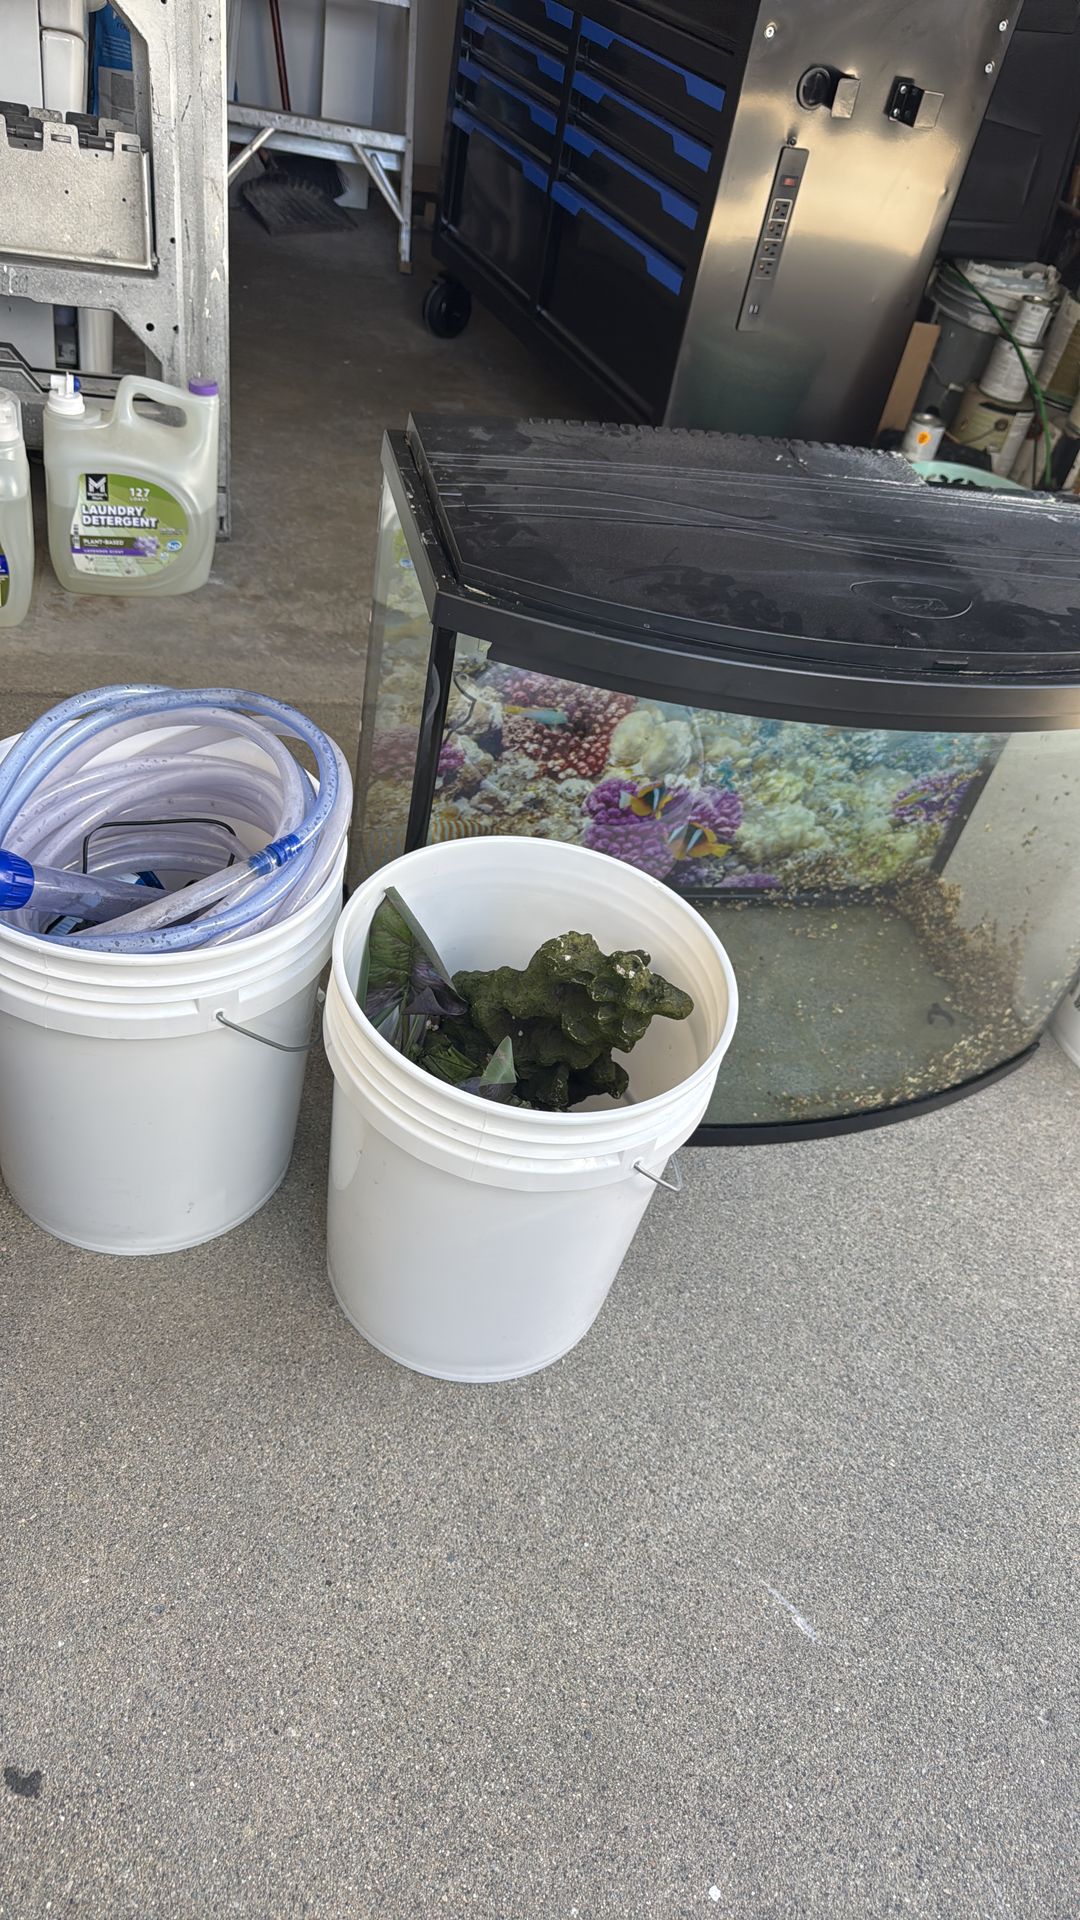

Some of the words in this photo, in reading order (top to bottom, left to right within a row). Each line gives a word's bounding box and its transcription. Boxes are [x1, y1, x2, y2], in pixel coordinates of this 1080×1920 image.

[129, 487, 150, 497] 127
[82, 505, 144, 516] LAUNDRY
[82, 515, 158, 528] DETERGENT
